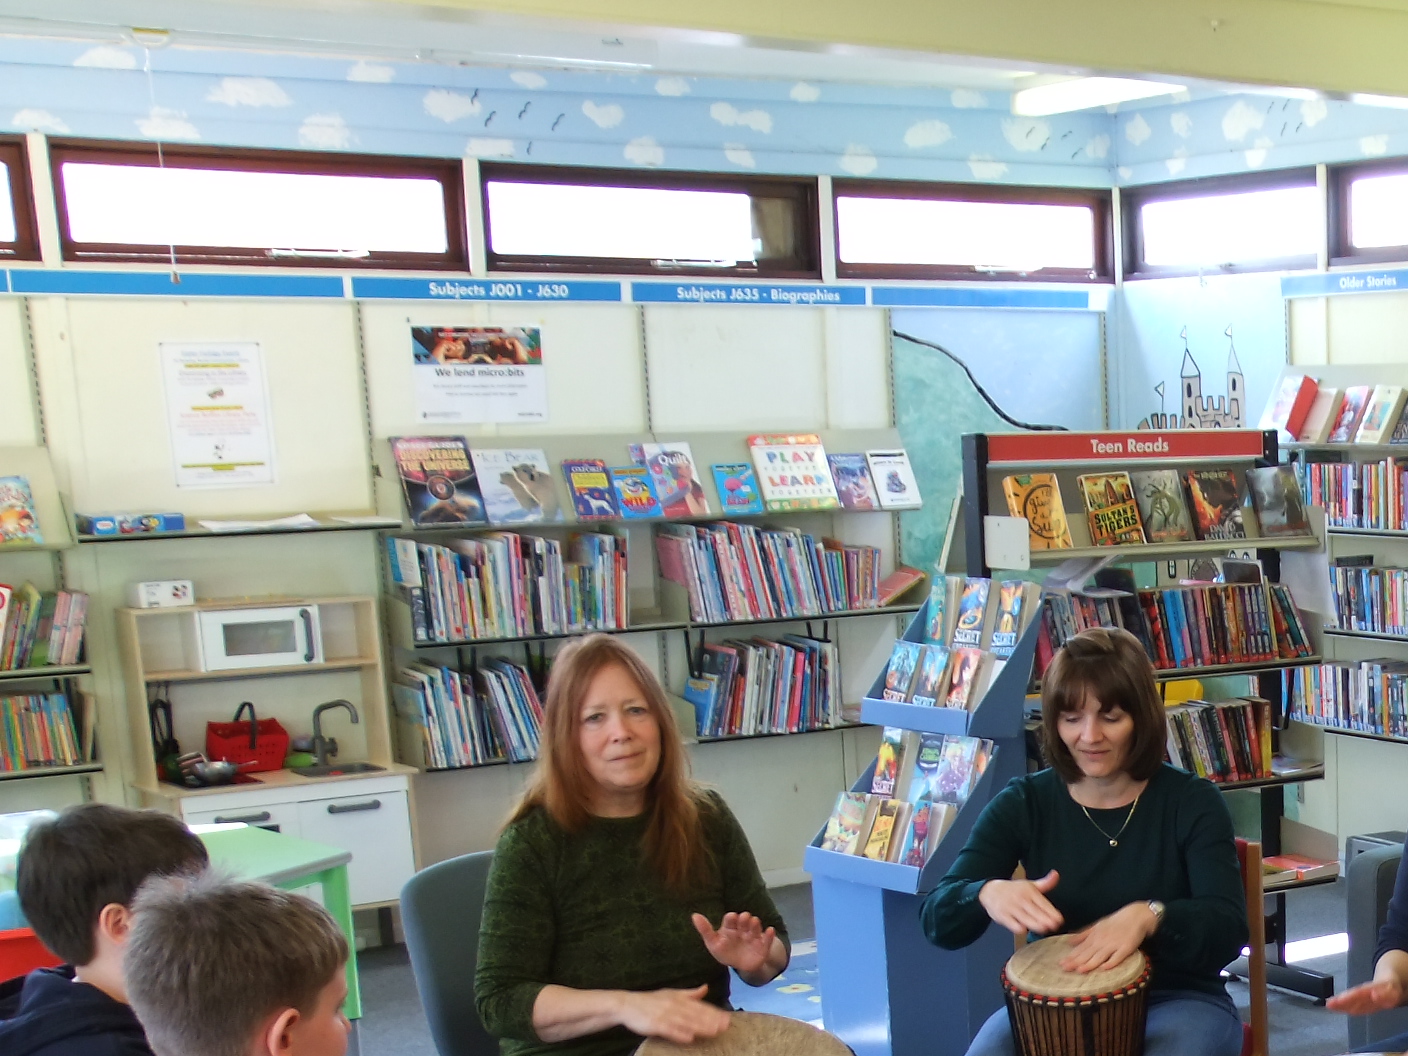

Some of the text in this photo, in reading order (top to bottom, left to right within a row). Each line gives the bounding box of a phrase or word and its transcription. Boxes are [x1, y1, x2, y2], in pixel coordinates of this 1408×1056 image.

[1339, 274, 1397, 289] Older Stories
[429, 282, 486, 298] Subjects
[490, 283, 522, 297] J001
[536, 283, 569, 297] J630
[676, 286, 727, 302] Subjects
[729, 287, 759, 301] J635
[770, 288, 840, 303] Biographies
[434, 367, 525, 379] We lend micro:bits
[1091, 437, 1169, 453] Teen Reads
[658, 453, 689, 467] Quilt
[766, 451, 816, 464] PLAY
[1097, 516, 1138, 535] TIGERS
